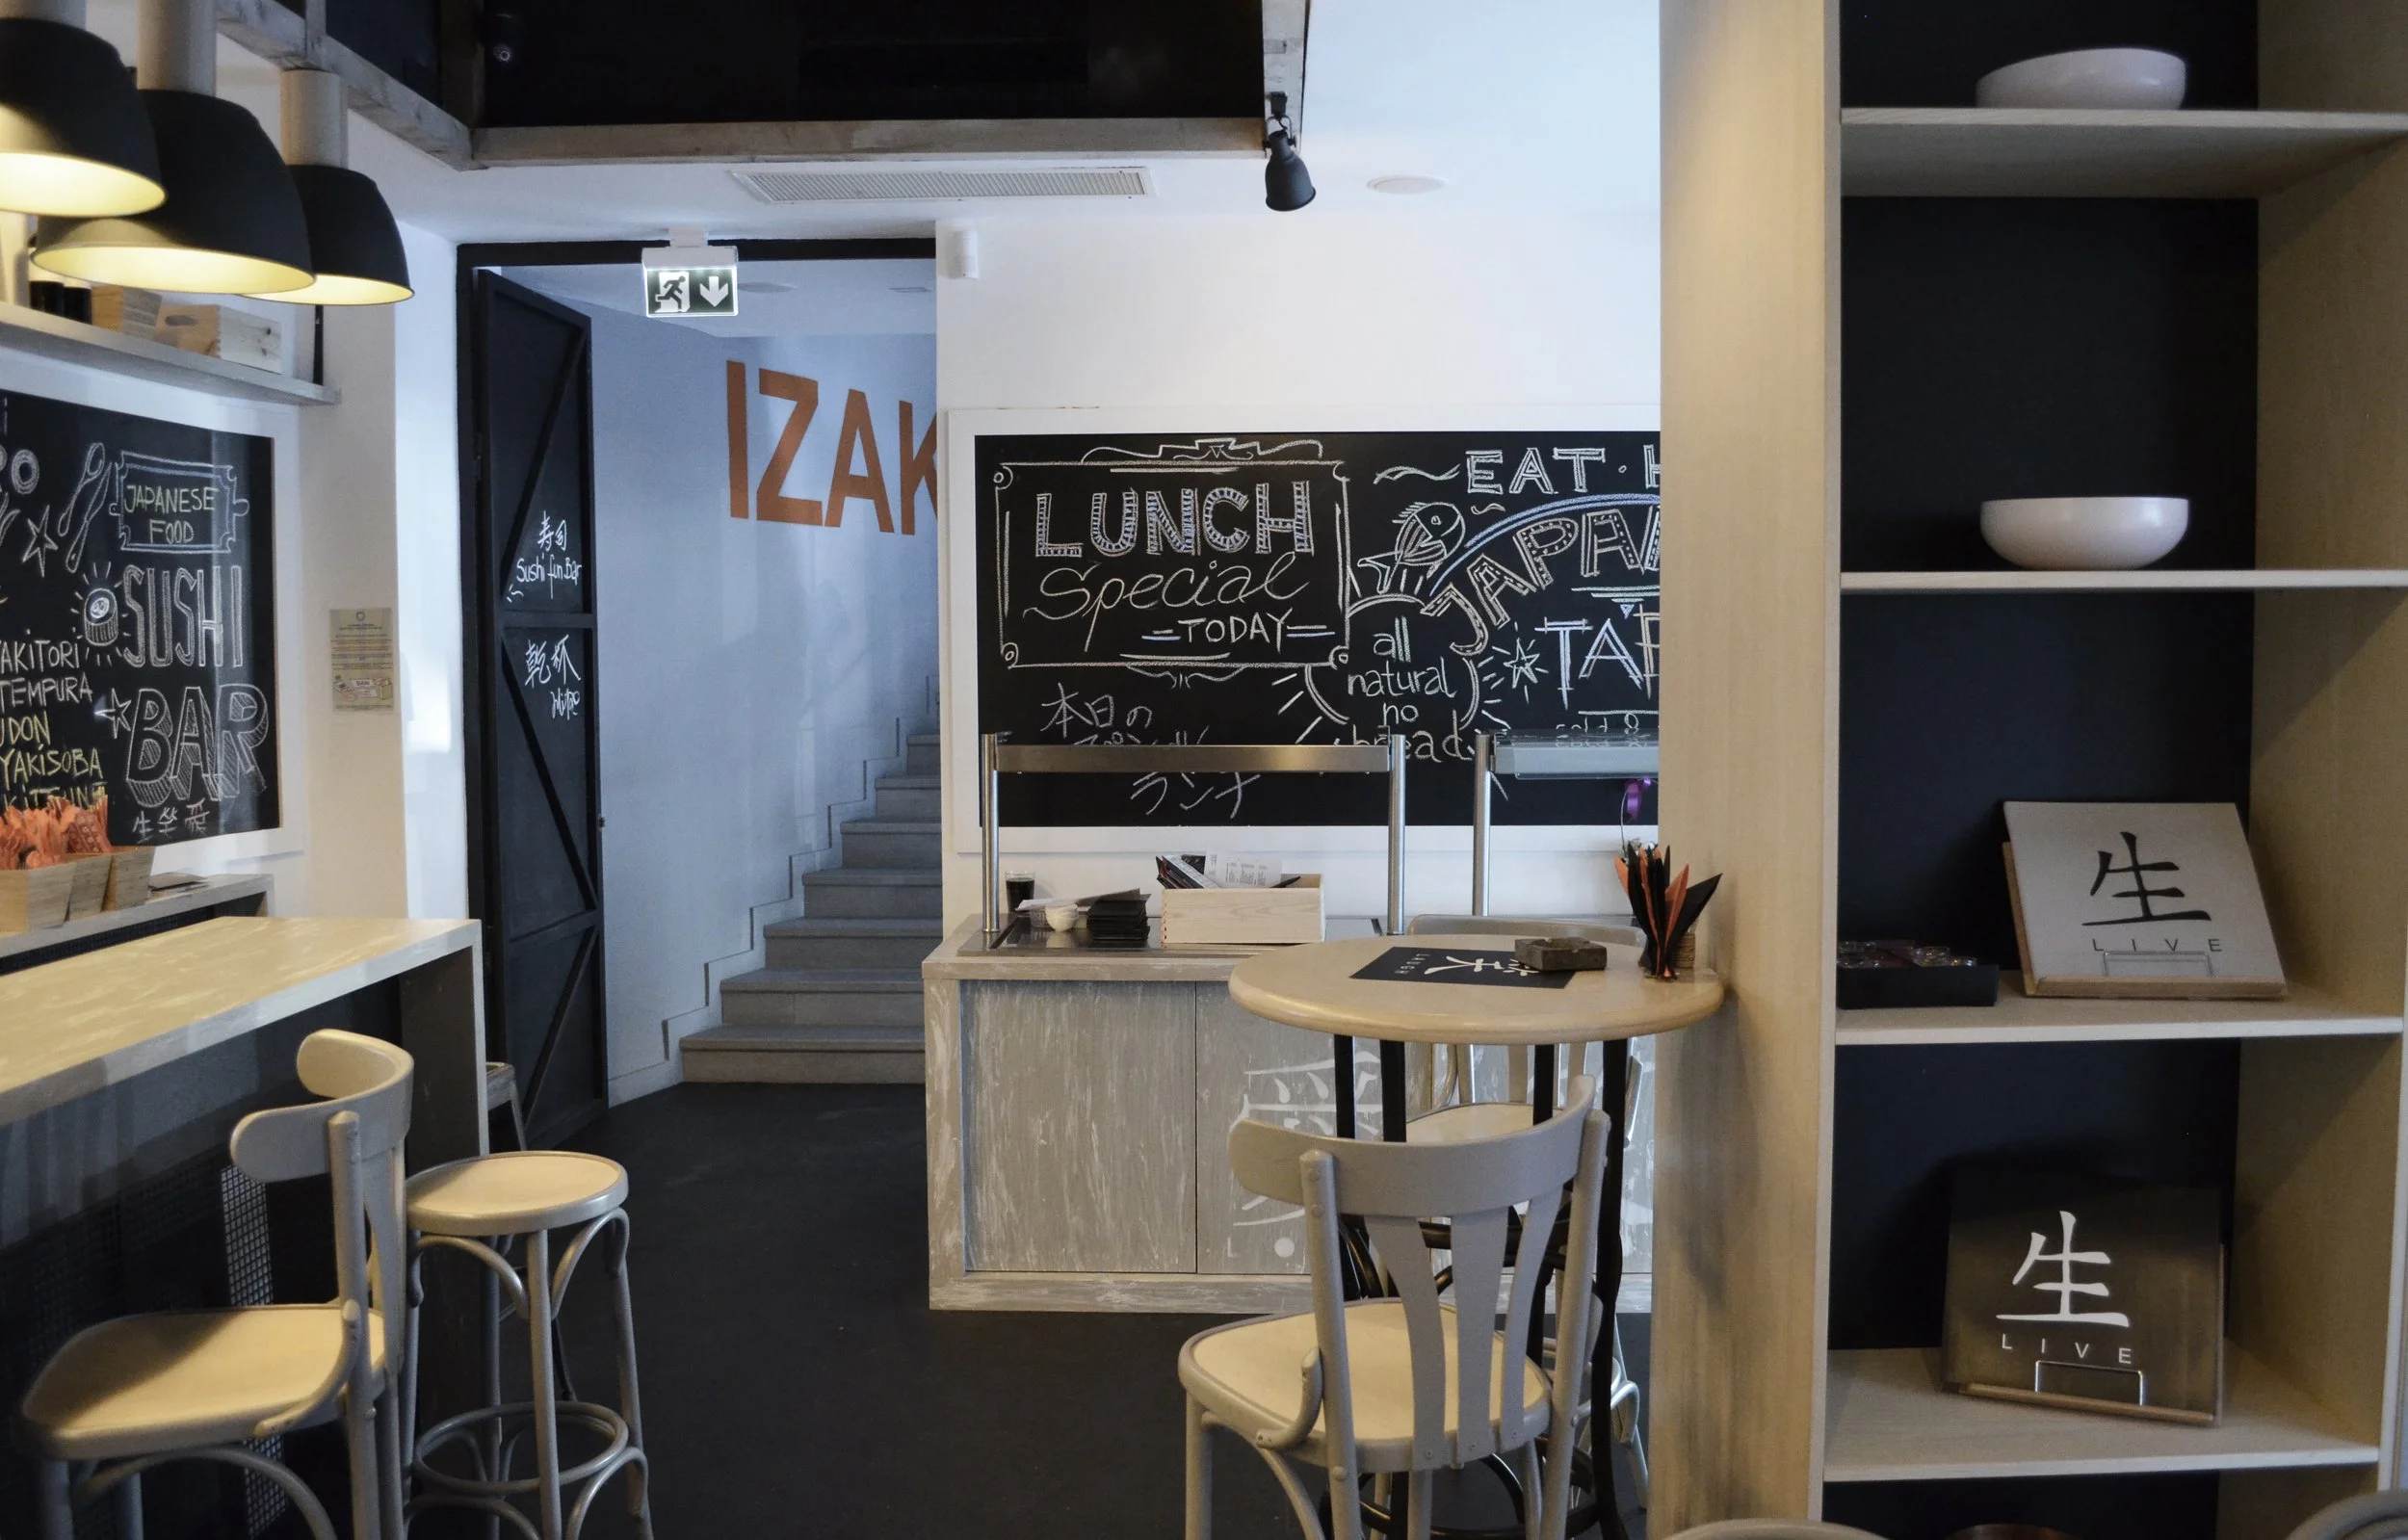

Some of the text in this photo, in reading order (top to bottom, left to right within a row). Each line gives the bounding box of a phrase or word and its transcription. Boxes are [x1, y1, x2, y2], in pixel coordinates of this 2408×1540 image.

[726, 360, 938, 535] IZAK
[1465, 447, 1606, 494] EAT
[123, 483, 219, 513] JAPANESE
[1035, 481, 1315, 557] LUNCH
[148, 520, 195, 544] FOOD
[516, 553, 545, 583] Sushi
[563, 557, 582, 586] Bar
[123, 564, 243, 667] SUSHI
[1022, 552, 1309, 652] Special
[0, 628, 80, 674] AKITORI
[1178, 609, 1292, 653] TODAY
[1373, 615, 1411, 663] all
[0, 672, 92, 714] TEMPURA
[1348, 656, 1456, 698] natural
[1040, 682, 1152, 739] 本日の
[1382, 702, 1419, 725] no
[125, 683, 270, 808] BAR
[2081, 831, 2212, 926] 生
[2092, 938, 2222, 953] LIVE
[1996, 1211, 2130, 1328] 生
[2002, 1333, 2132, 1365] LIVE
